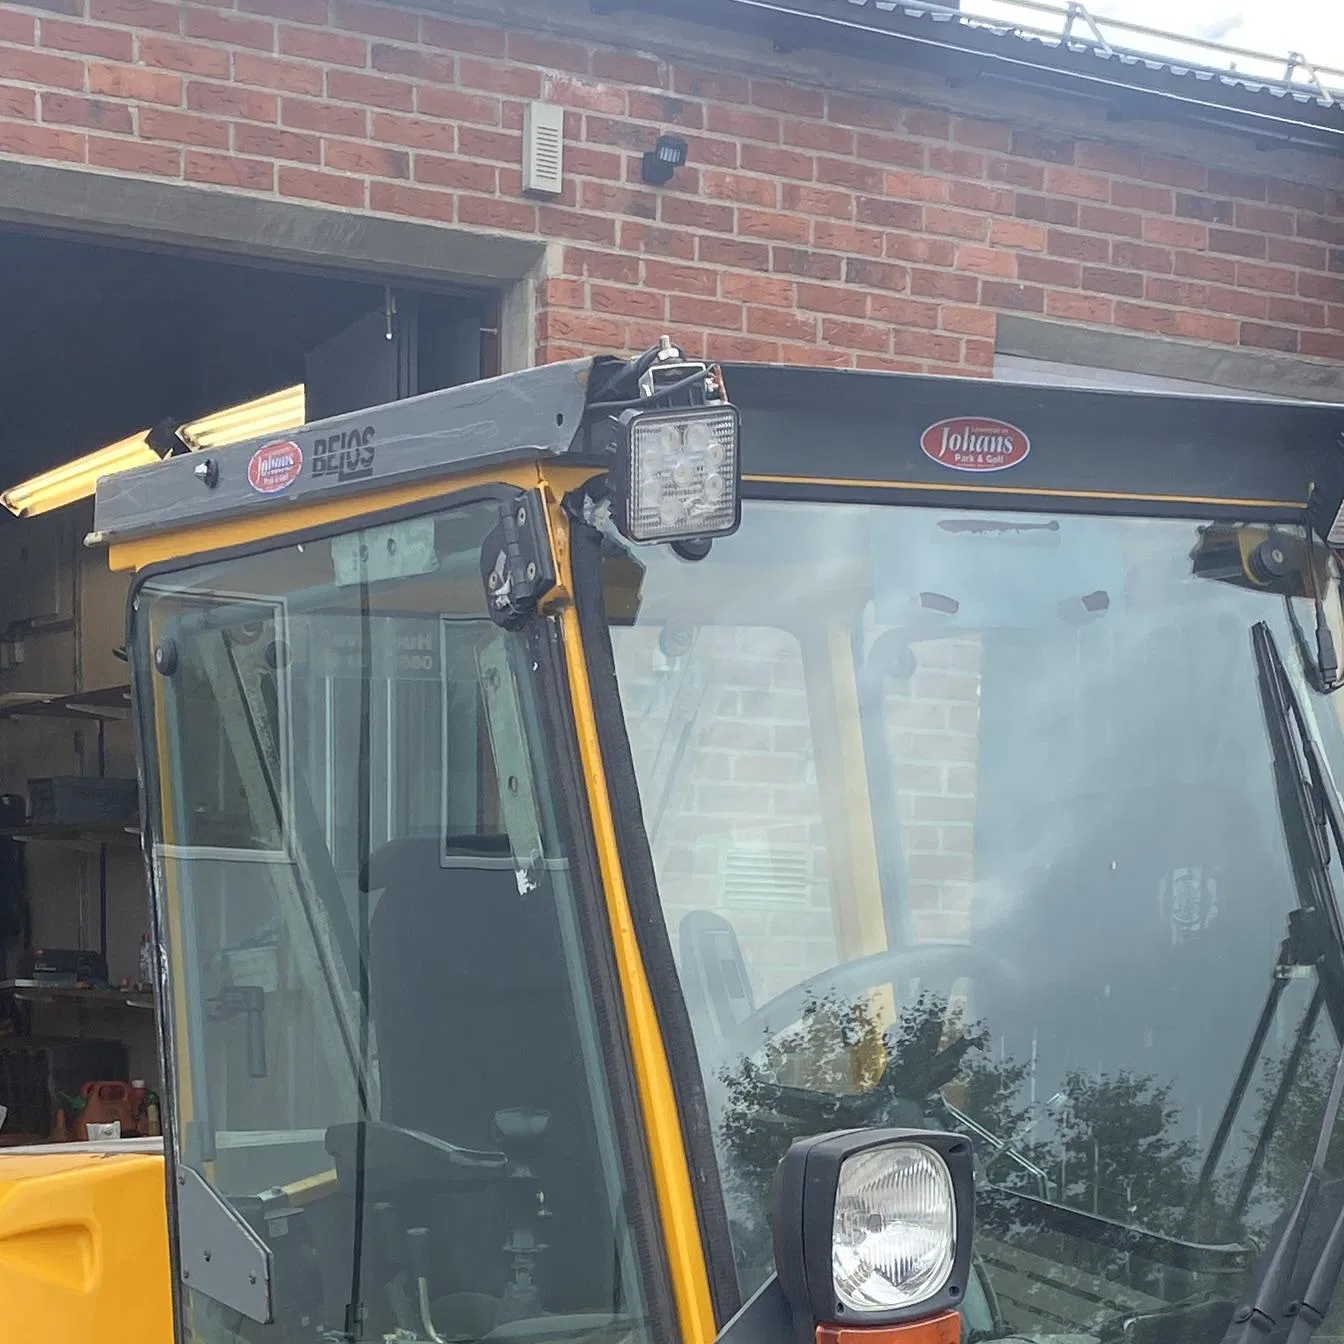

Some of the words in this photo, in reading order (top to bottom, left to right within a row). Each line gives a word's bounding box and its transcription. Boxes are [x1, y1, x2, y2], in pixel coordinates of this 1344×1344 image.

[938, 425, 1014, 458] Johans
[955, 453, 976, 463] Park
[977, 454, 984, 464] &
